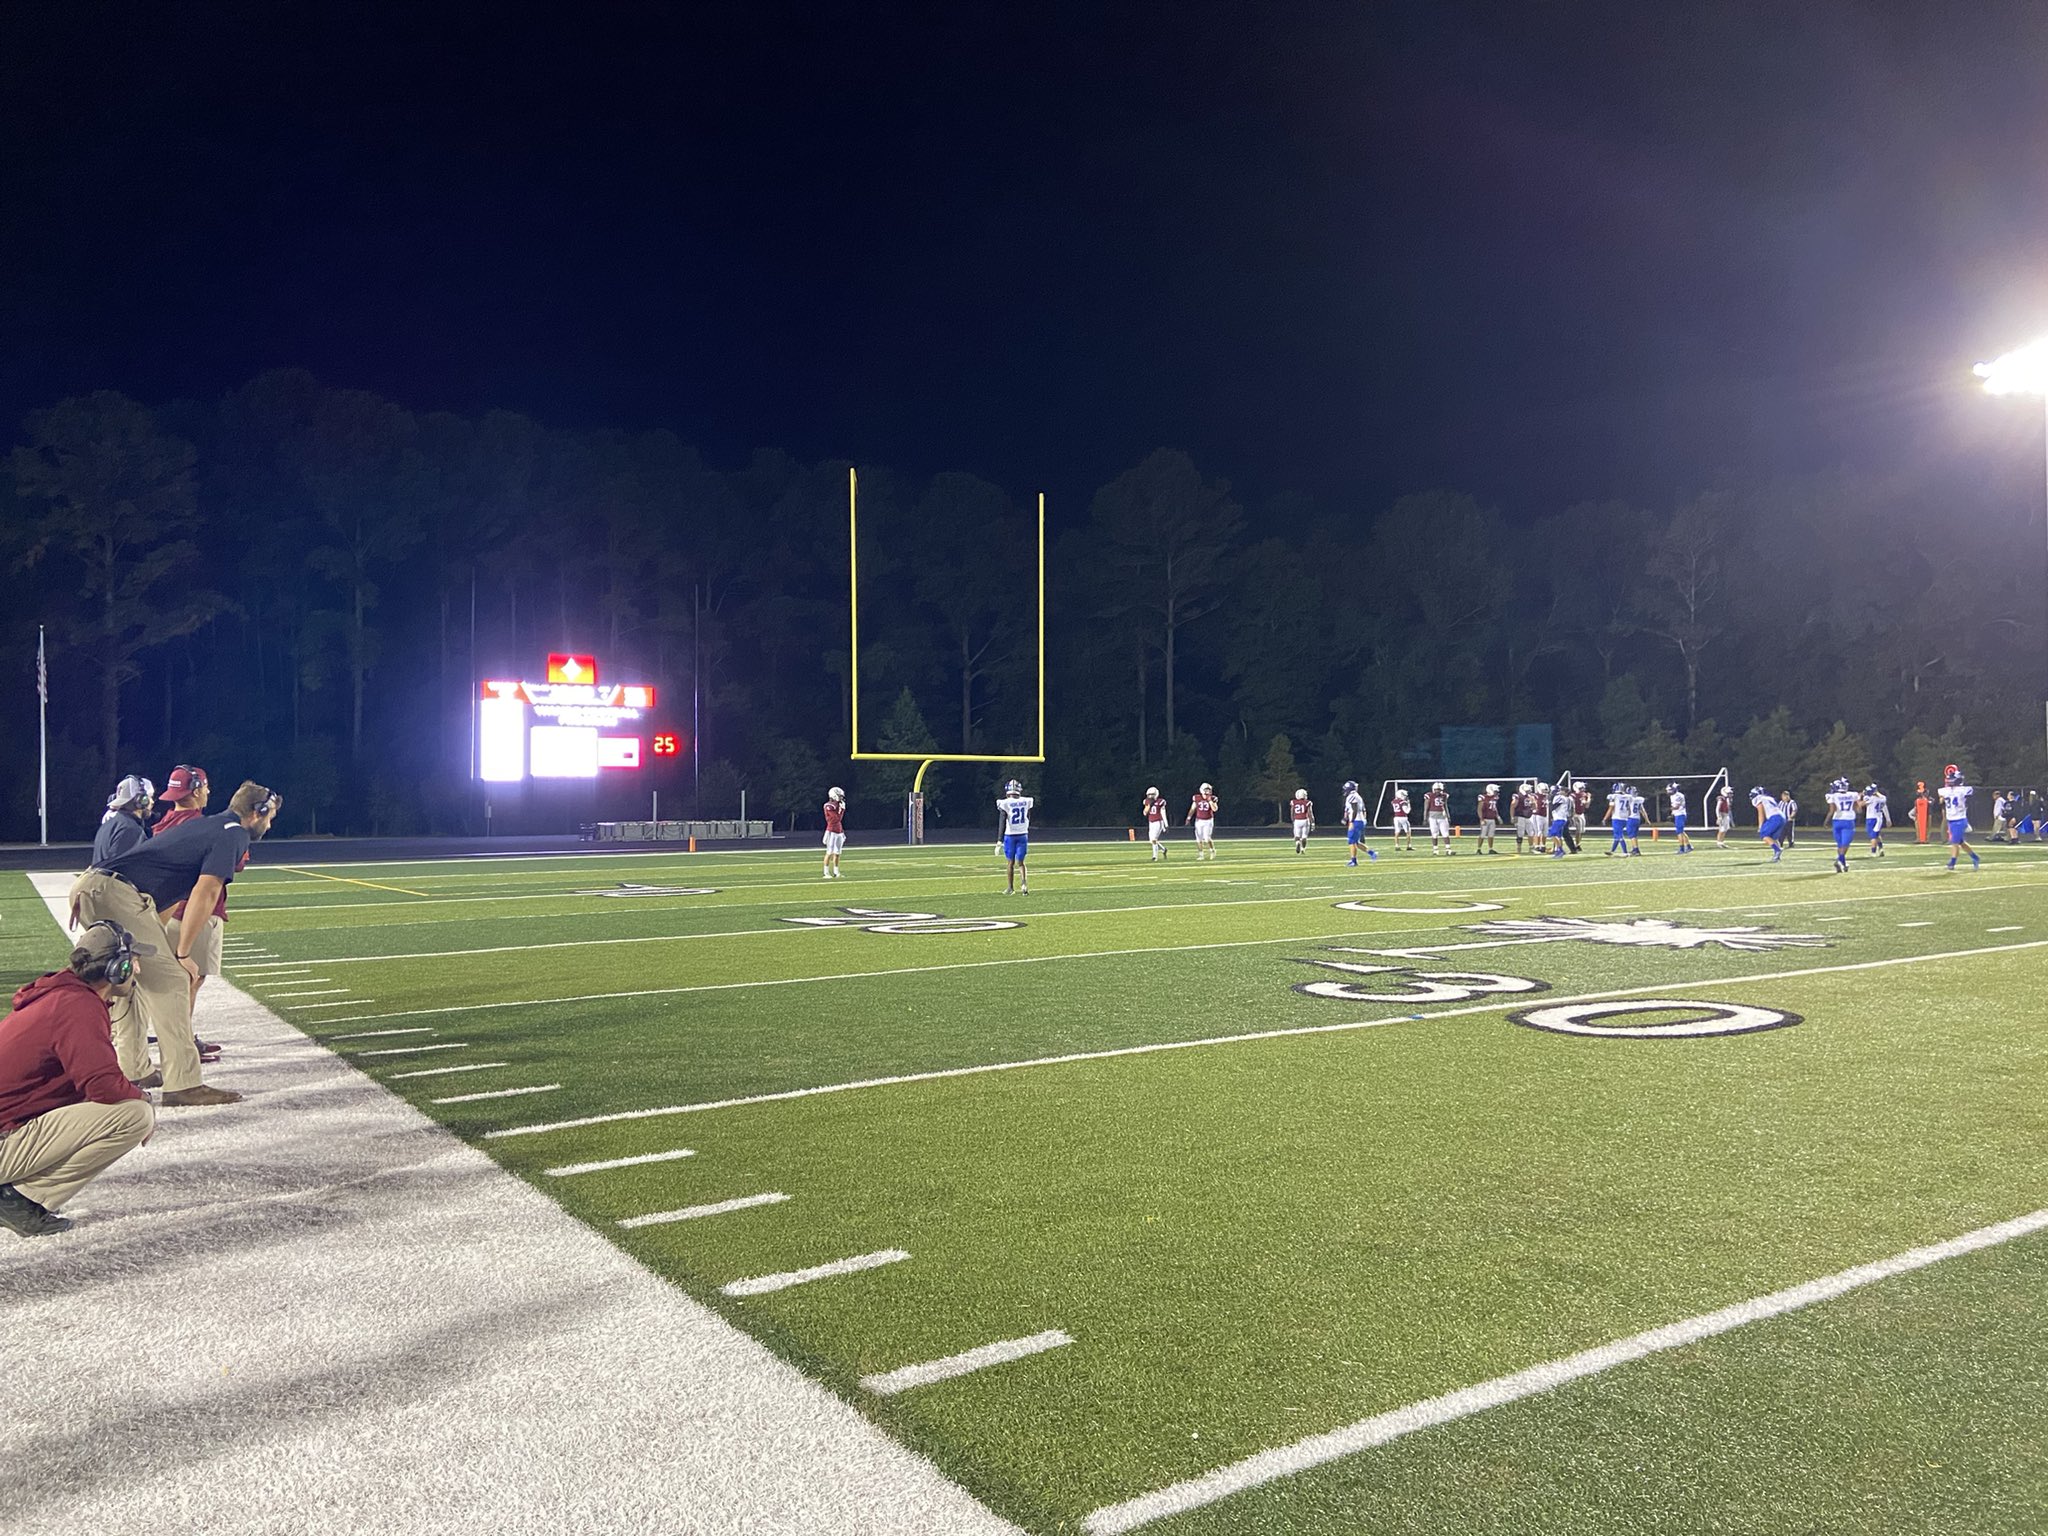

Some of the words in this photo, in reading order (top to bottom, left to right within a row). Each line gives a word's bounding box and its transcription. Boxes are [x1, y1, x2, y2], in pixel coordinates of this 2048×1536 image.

[654, 736, 675, 752] 25
[1198, 802, 1209, 811] 33
[1295, 804, 1305, 814] 21
[1840, 801, 1852, 811] 17
[1011, 807, 1025, 824] 21
[1291, 971, 1804, 1039] 30
